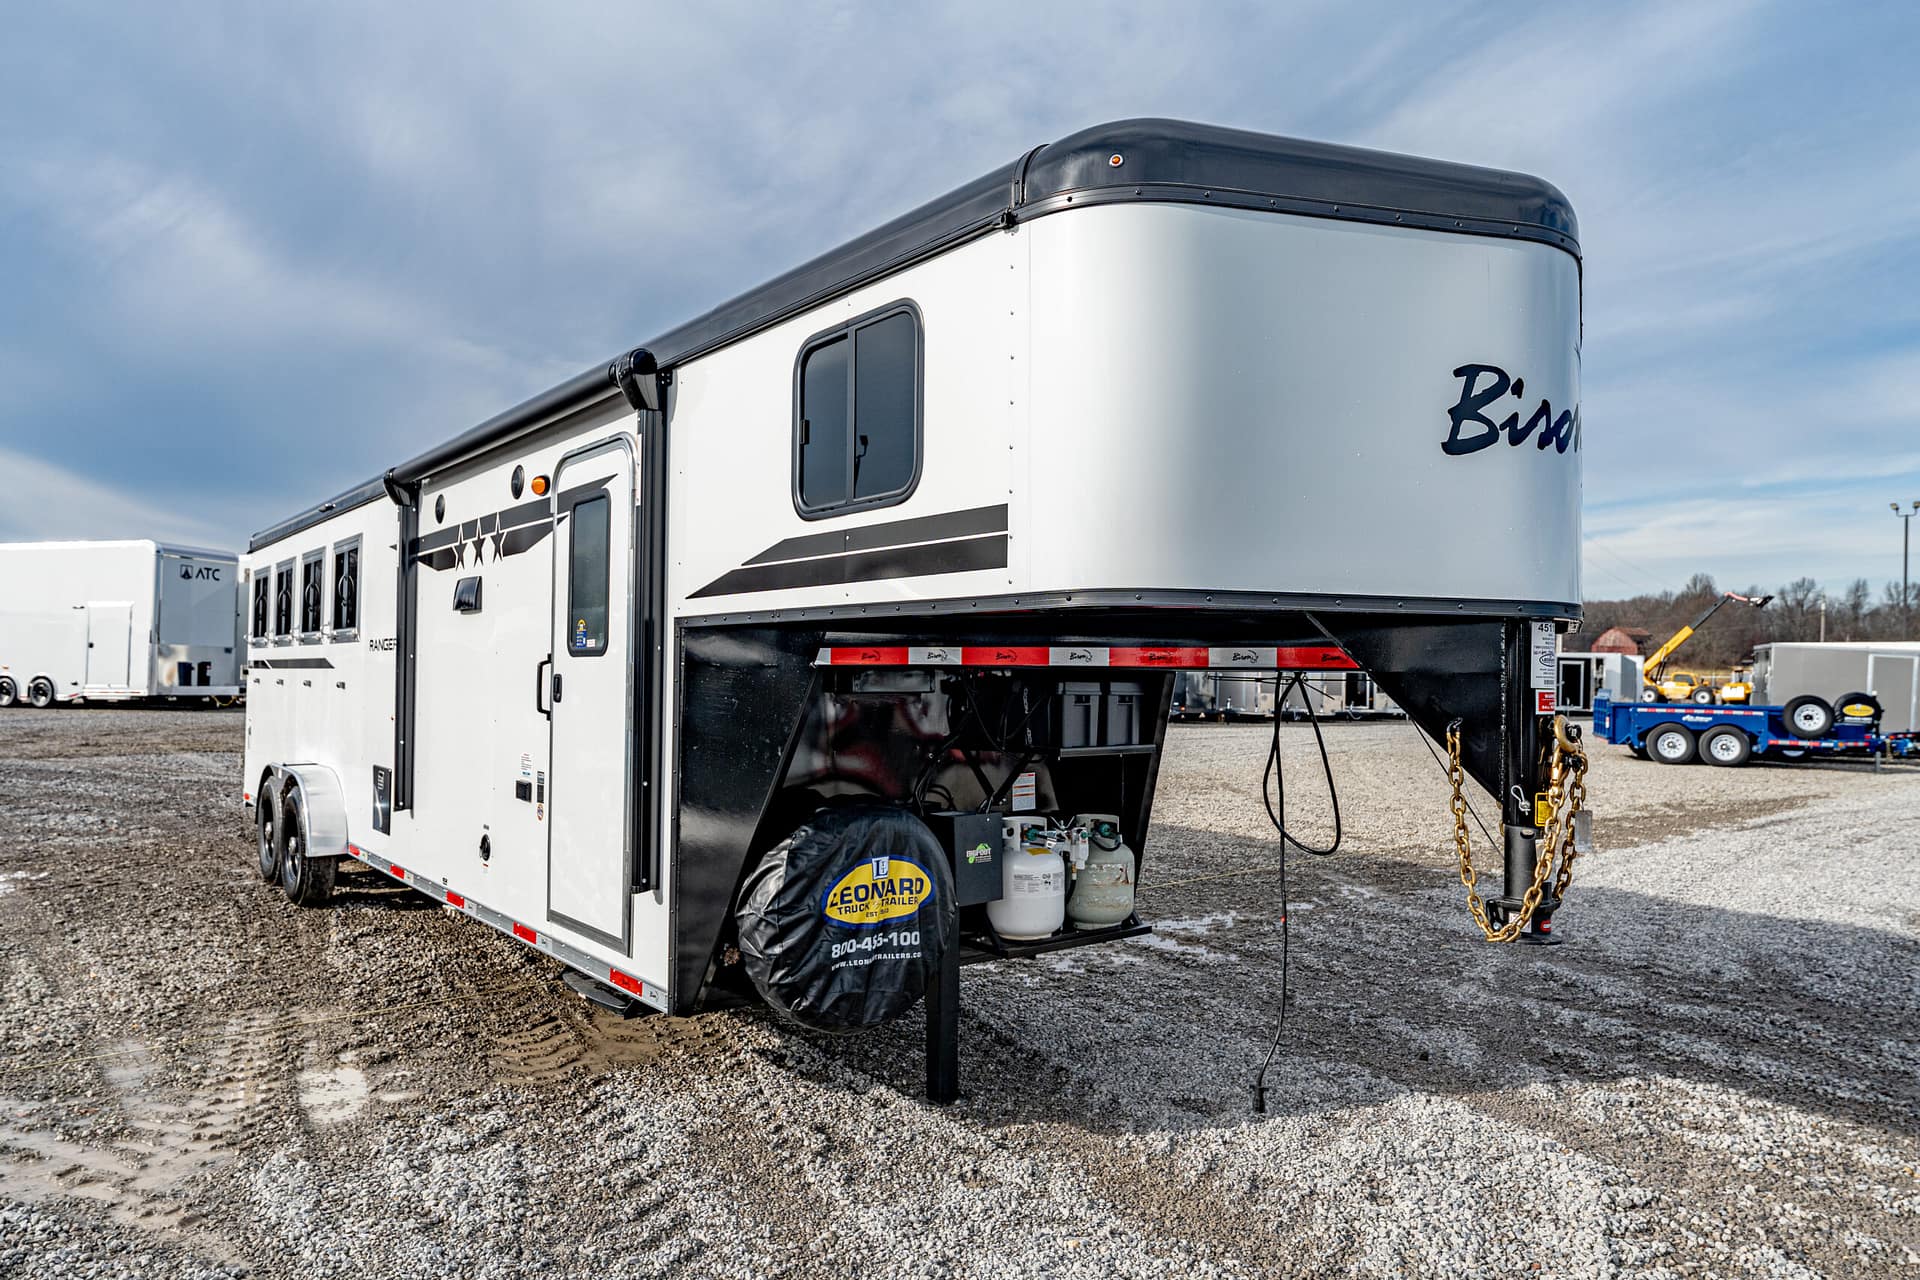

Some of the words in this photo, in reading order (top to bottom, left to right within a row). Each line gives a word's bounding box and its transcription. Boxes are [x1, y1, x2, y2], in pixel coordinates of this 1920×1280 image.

[195, 567, 221, 582] ATC
[829, 877, 925, 908] LEONARD
[837, 903, 870, 915] TRUCK
[881, 896, 919, 906] TRAILER
